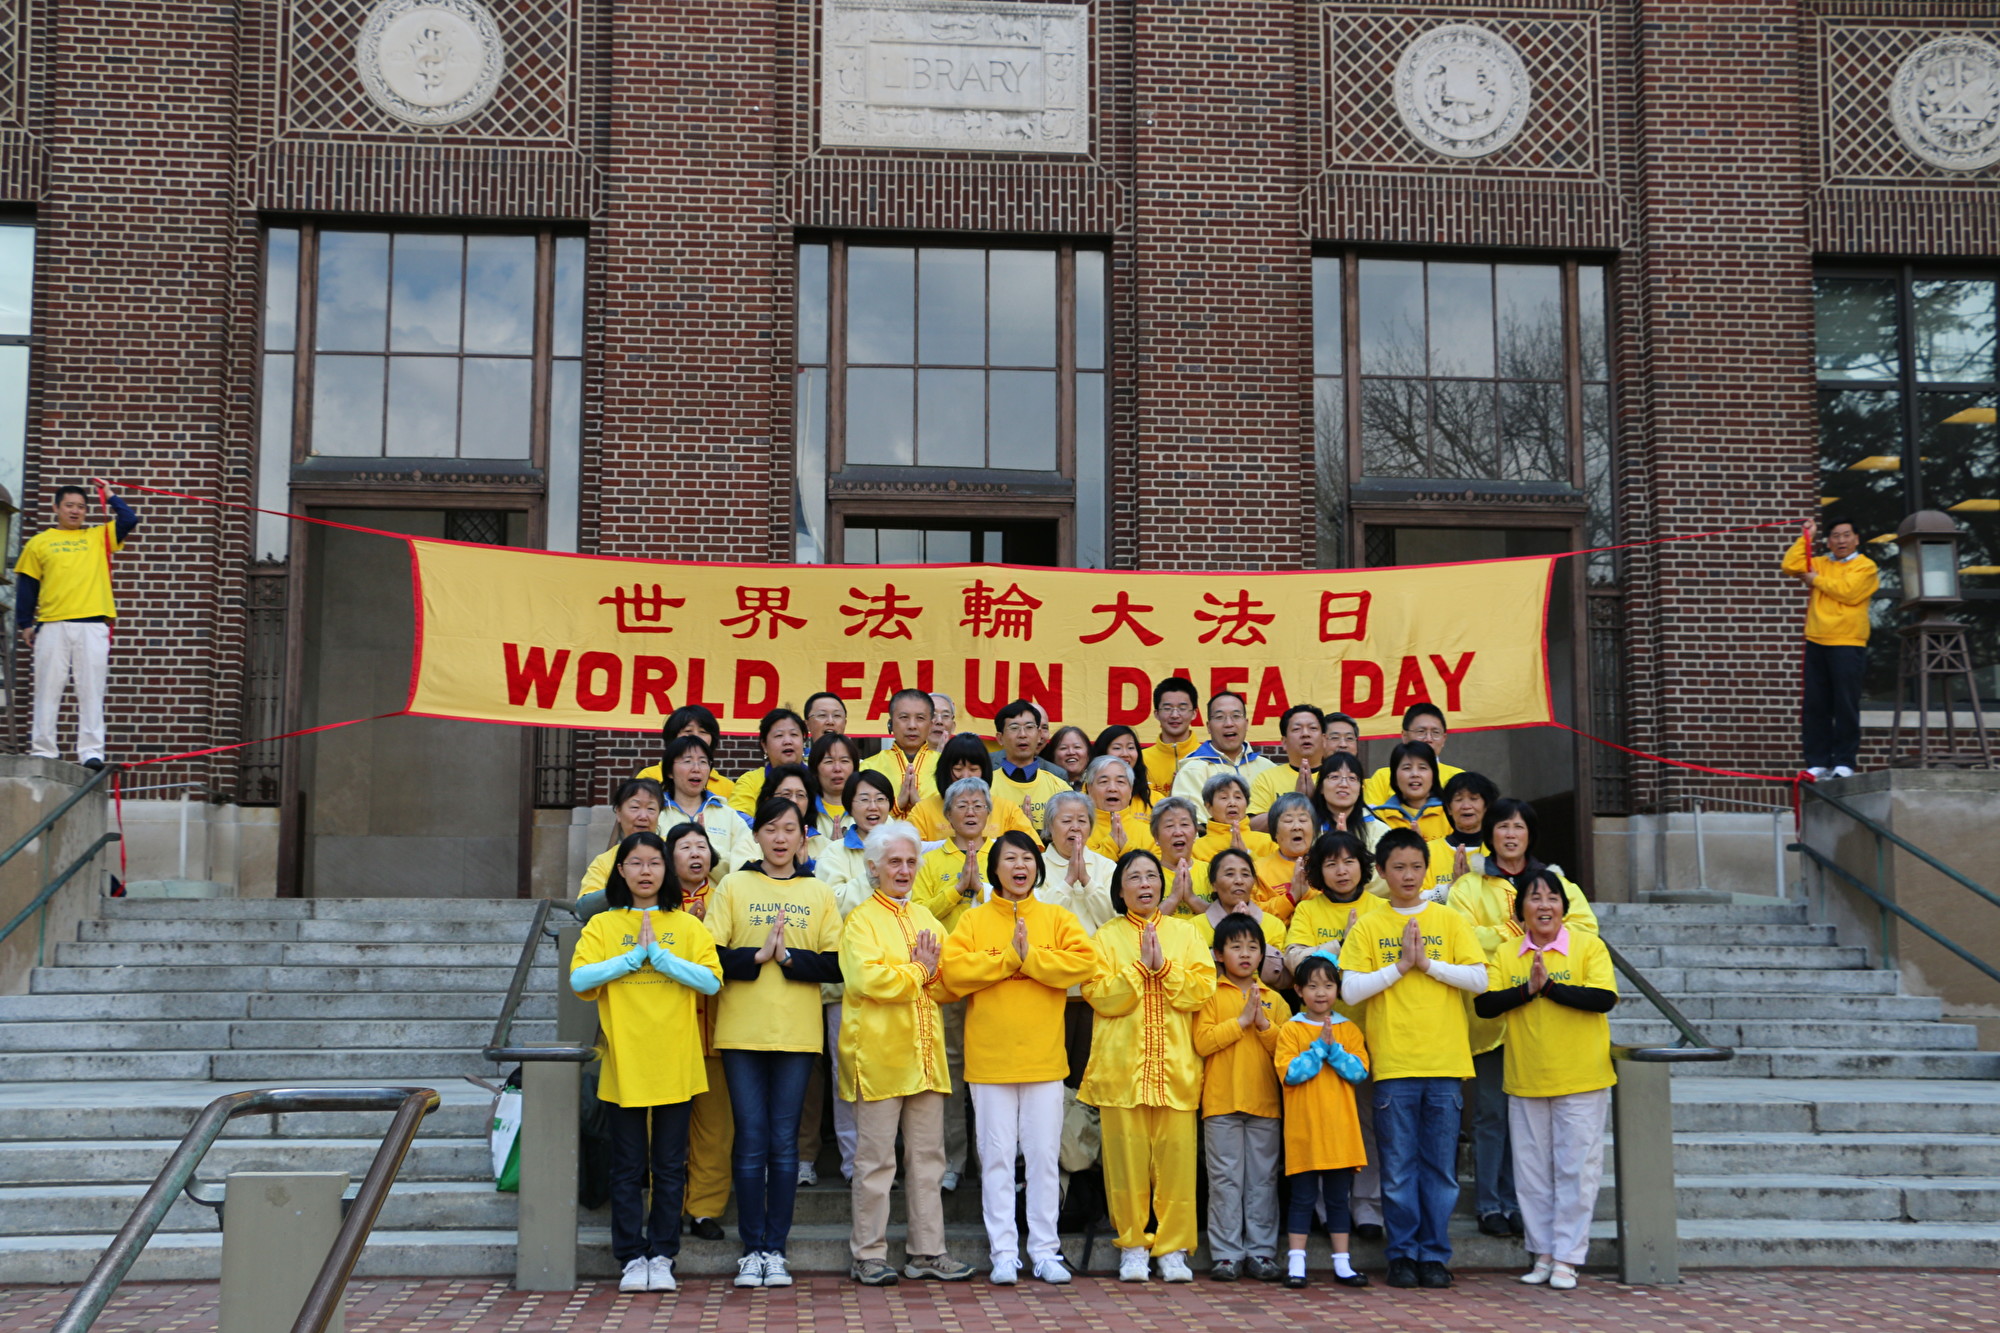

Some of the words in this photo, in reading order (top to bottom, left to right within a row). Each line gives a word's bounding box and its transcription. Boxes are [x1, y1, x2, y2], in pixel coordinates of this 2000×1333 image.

[881, 57, 1030, 93] LIBRARY
[599, 579, 1372, 647] 世界法輪大法日
[502, 642, 780, 720] WORLD
[1107, 666, 1293, 727] DFA
[1339, 651, 1477, 719] DAY
[749, 903, 781, 912] FALUN
[784, 903, 811, 916] GONG
[1548, 970, 1571, 982] ONG
